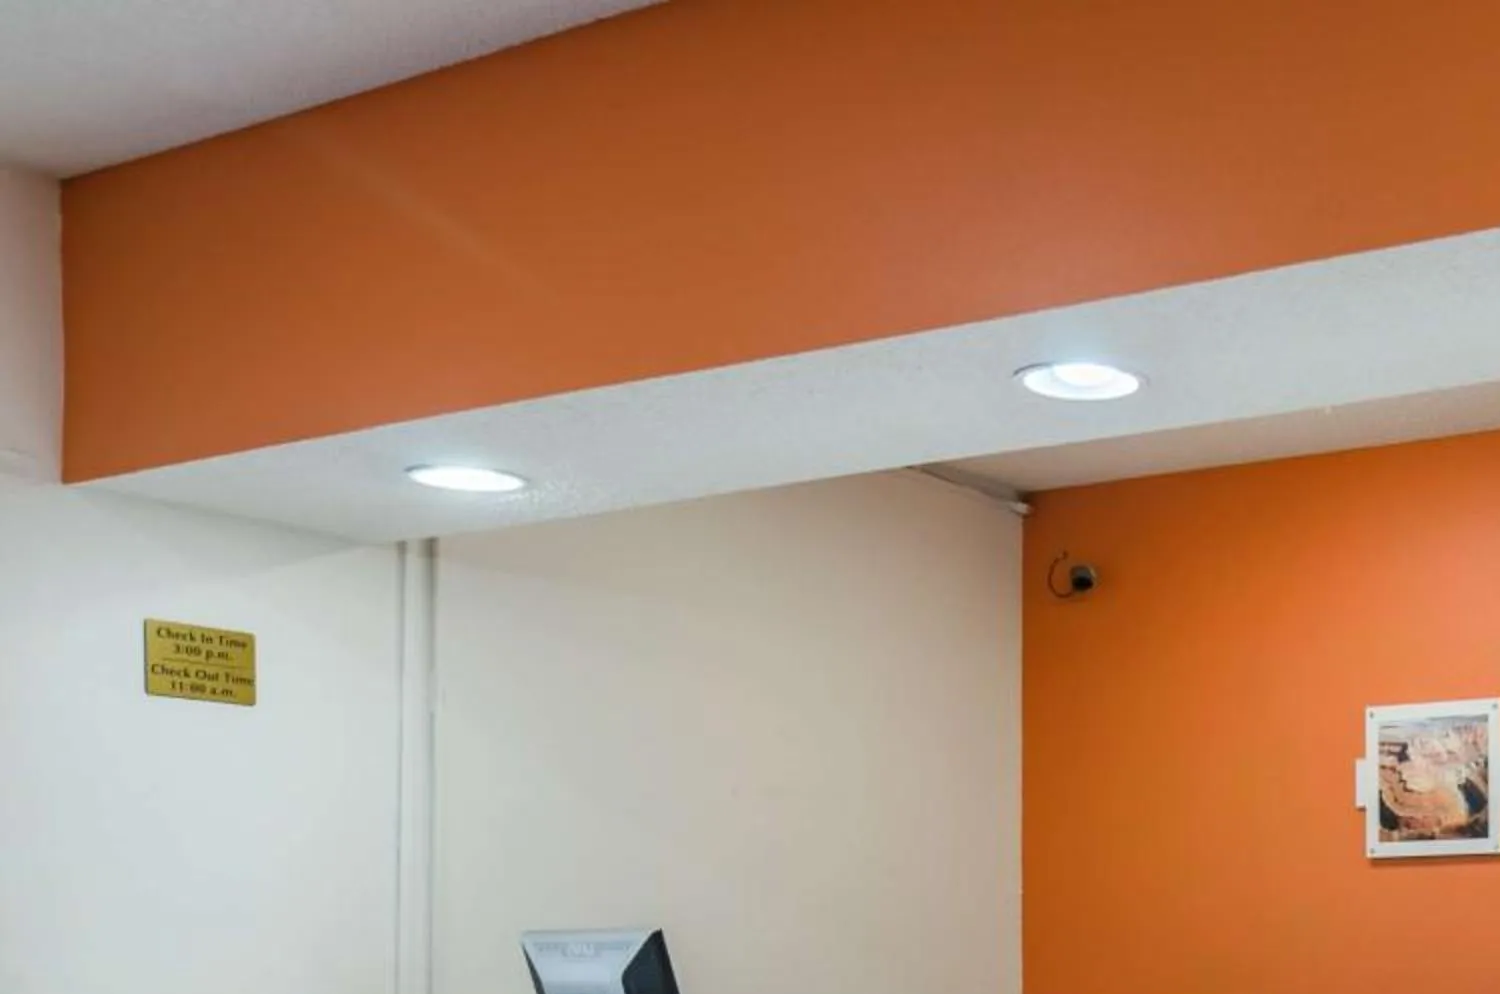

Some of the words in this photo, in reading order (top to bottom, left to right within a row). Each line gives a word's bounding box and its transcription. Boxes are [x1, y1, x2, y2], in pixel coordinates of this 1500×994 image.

[156, 626, 196, 642] Check
[201, 632, 213, 645] In
[219, 635, 249, 650] Time
[151, 663, 190, 678] Check
[195, 669, 219, 681] Out
[224, 672, 255, 686] Time
